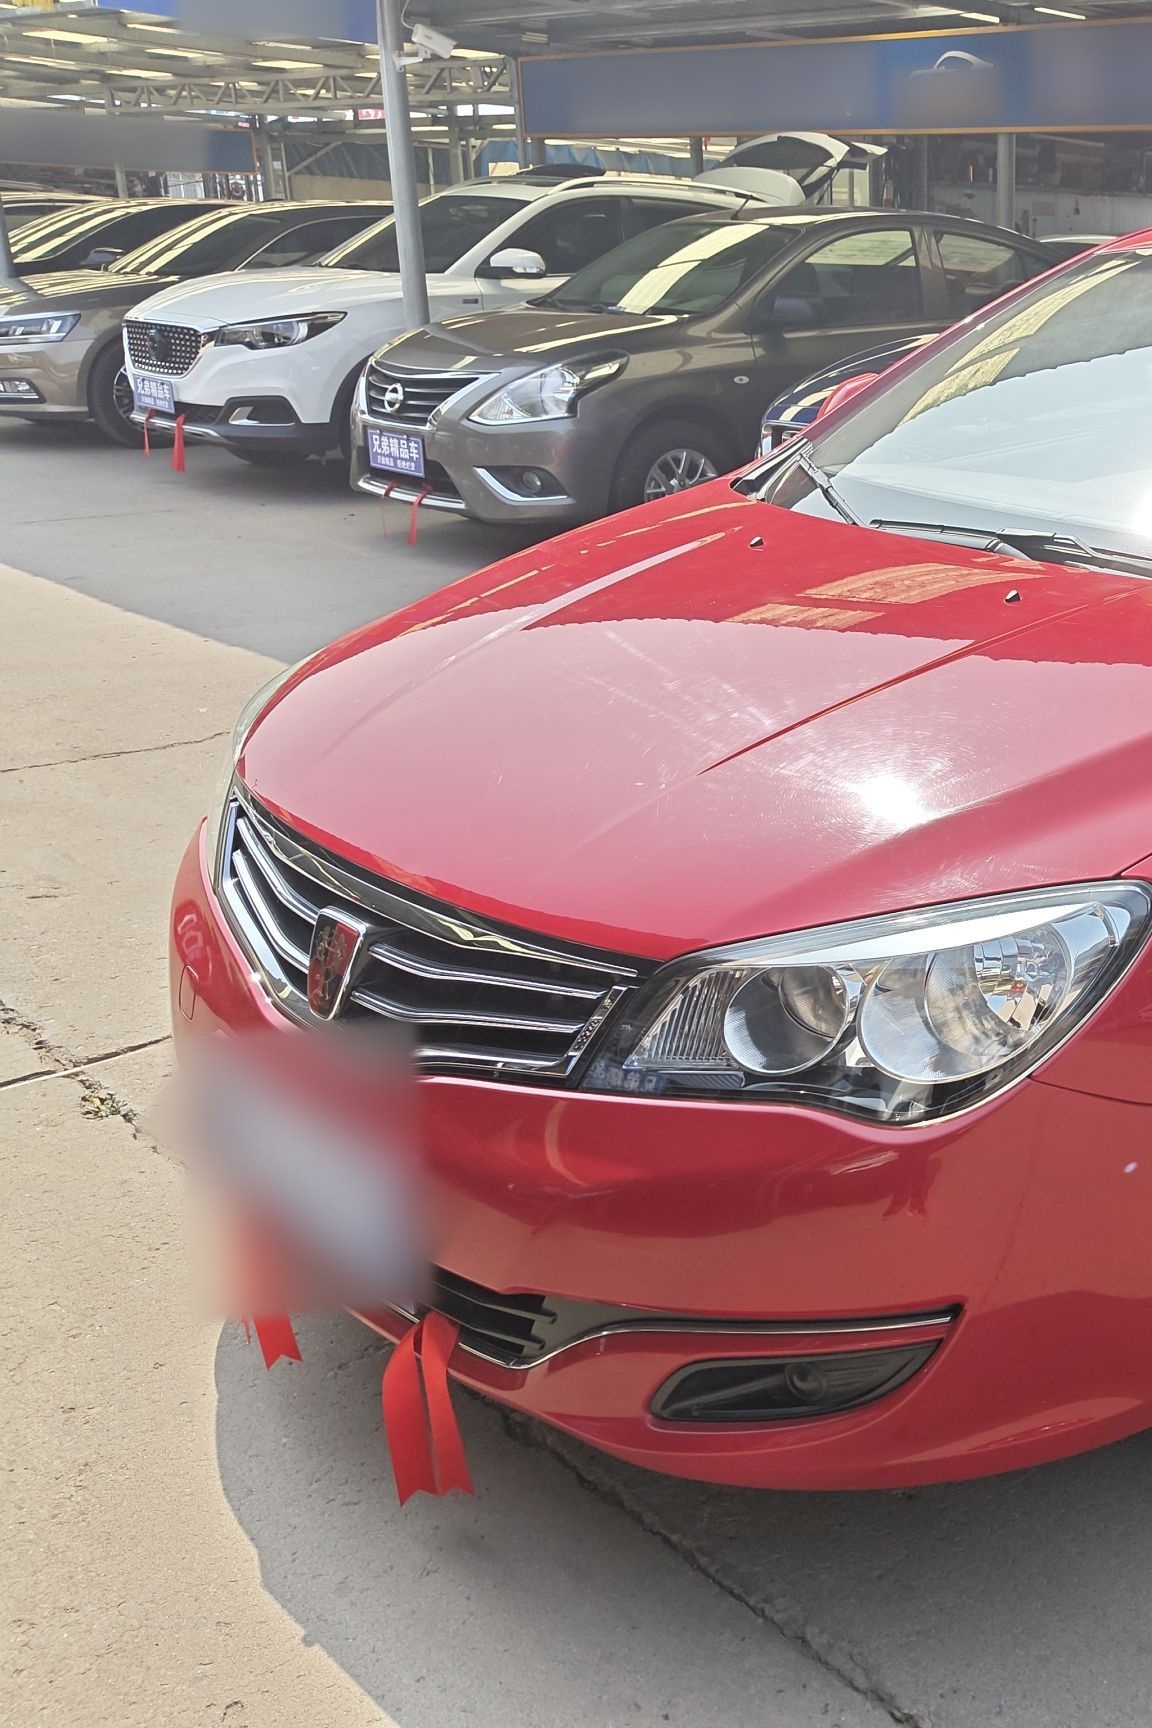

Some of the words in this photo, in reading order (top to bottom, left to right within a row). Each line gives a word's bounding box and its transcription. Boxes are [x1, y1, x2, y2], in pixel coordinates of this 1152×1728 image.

[136, 378, 171, 400] 兄弟精品车
[372, 434, 420, 461] 兄弟精品车
